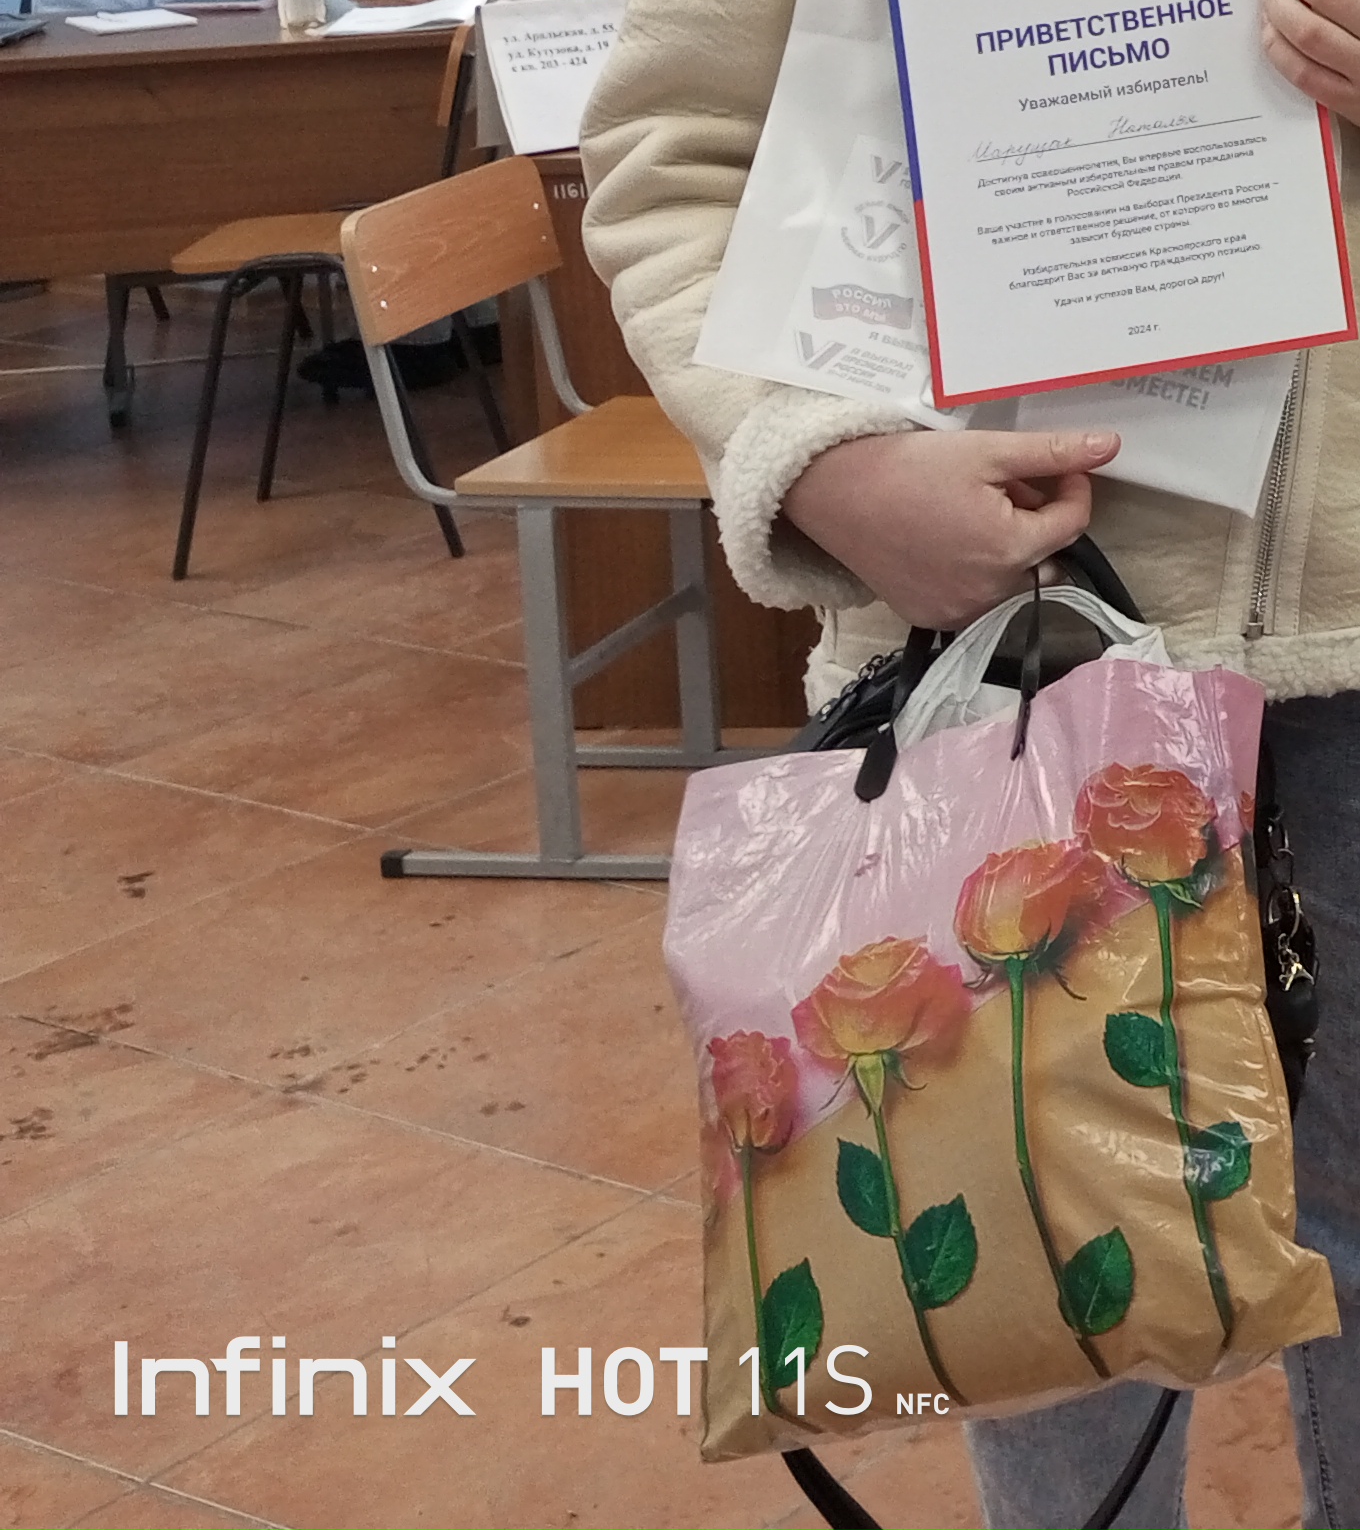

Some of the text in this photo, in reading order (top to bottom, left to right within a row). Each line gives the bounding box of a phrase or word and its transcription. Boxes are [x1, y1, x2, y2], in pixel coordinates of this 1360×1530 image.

[569, 56, 588, 66] 424
[1047, 37, 1170, 76] ПИСЬМО
[1017, 69, 1208, 111] Уважаемый избиратель!
[977, 173, 1028, 189] Достигнув
[1122, 155, 1136, 164] Вы
[1138, 149, 1181, 162] впервые
[1182, 136, 1267, 154] воспользовались
[994, 149, 1254, 196] своим активным избирательным правом гражданина
[1066, 180, 1124, 197] Российской
[976, 225, 1003, 235] Ваше
[1004, 219, 1044, 232] участие
[1054, 207, 1116, 222] голосовании
[1118, 204, 1130, 212] на
[1132, 197, 1175, 210] выборах
[1176, 188, 1233, 203] Президента
[1235, 182, 1270, 193] России
[991, 233, 1028, 245] важное
[1039, 220, 1110, 237] ответственное
[1112, 213, 1157, 227] решение,
[1159, 210, 1170, 218] от
[1172, 203, 1215, 215] которого
[1217, 200, 1229, 208] во
[1231, 194, 1268, 206] многом
[1069, 232, 1108, 244] зависит
[1110, 225, 1152, 239] будущее
[1008, 275, 1065, 290] благодарит
[1067, 272, 1085, 281] Вас
[1100, 261, 1148, 275] активную
[1149, 251, 1215, 268] гражданскую
[1022, 233, 1246, 276] Избирательная комиссия Красноярского края
[1053, 296, 1084, 307] Удачи
[1094, 288, 1133, 302] успехов
[1134, 283, 1157, 293] Вам,
[1158, 275, 1199, 292] дорогой
[1200, 271, 1224, 284] друг!
[1127, 323, 1151, 335] 2024
